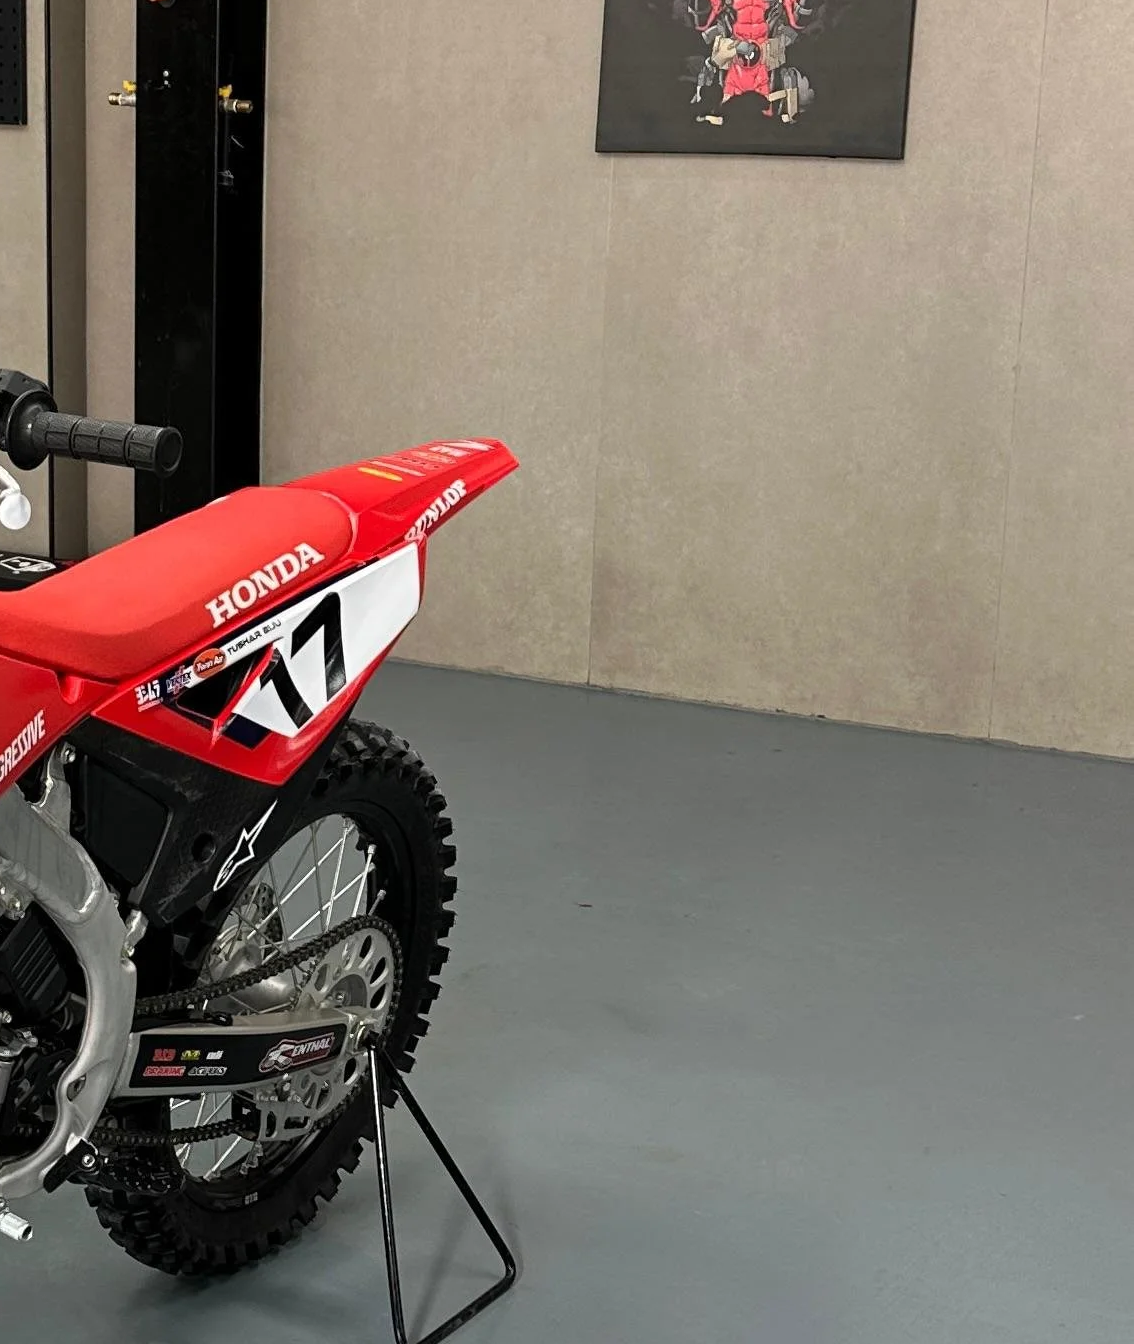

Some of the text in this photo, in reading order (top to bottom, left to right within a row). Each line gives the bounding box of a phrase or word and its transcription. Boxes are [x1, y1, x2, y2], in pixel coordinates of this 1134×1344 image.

[404, 479, 467, 542] DUNLOP
[205, 542, 325, 629] HONDA
[259, 591, 347, 730] 17
